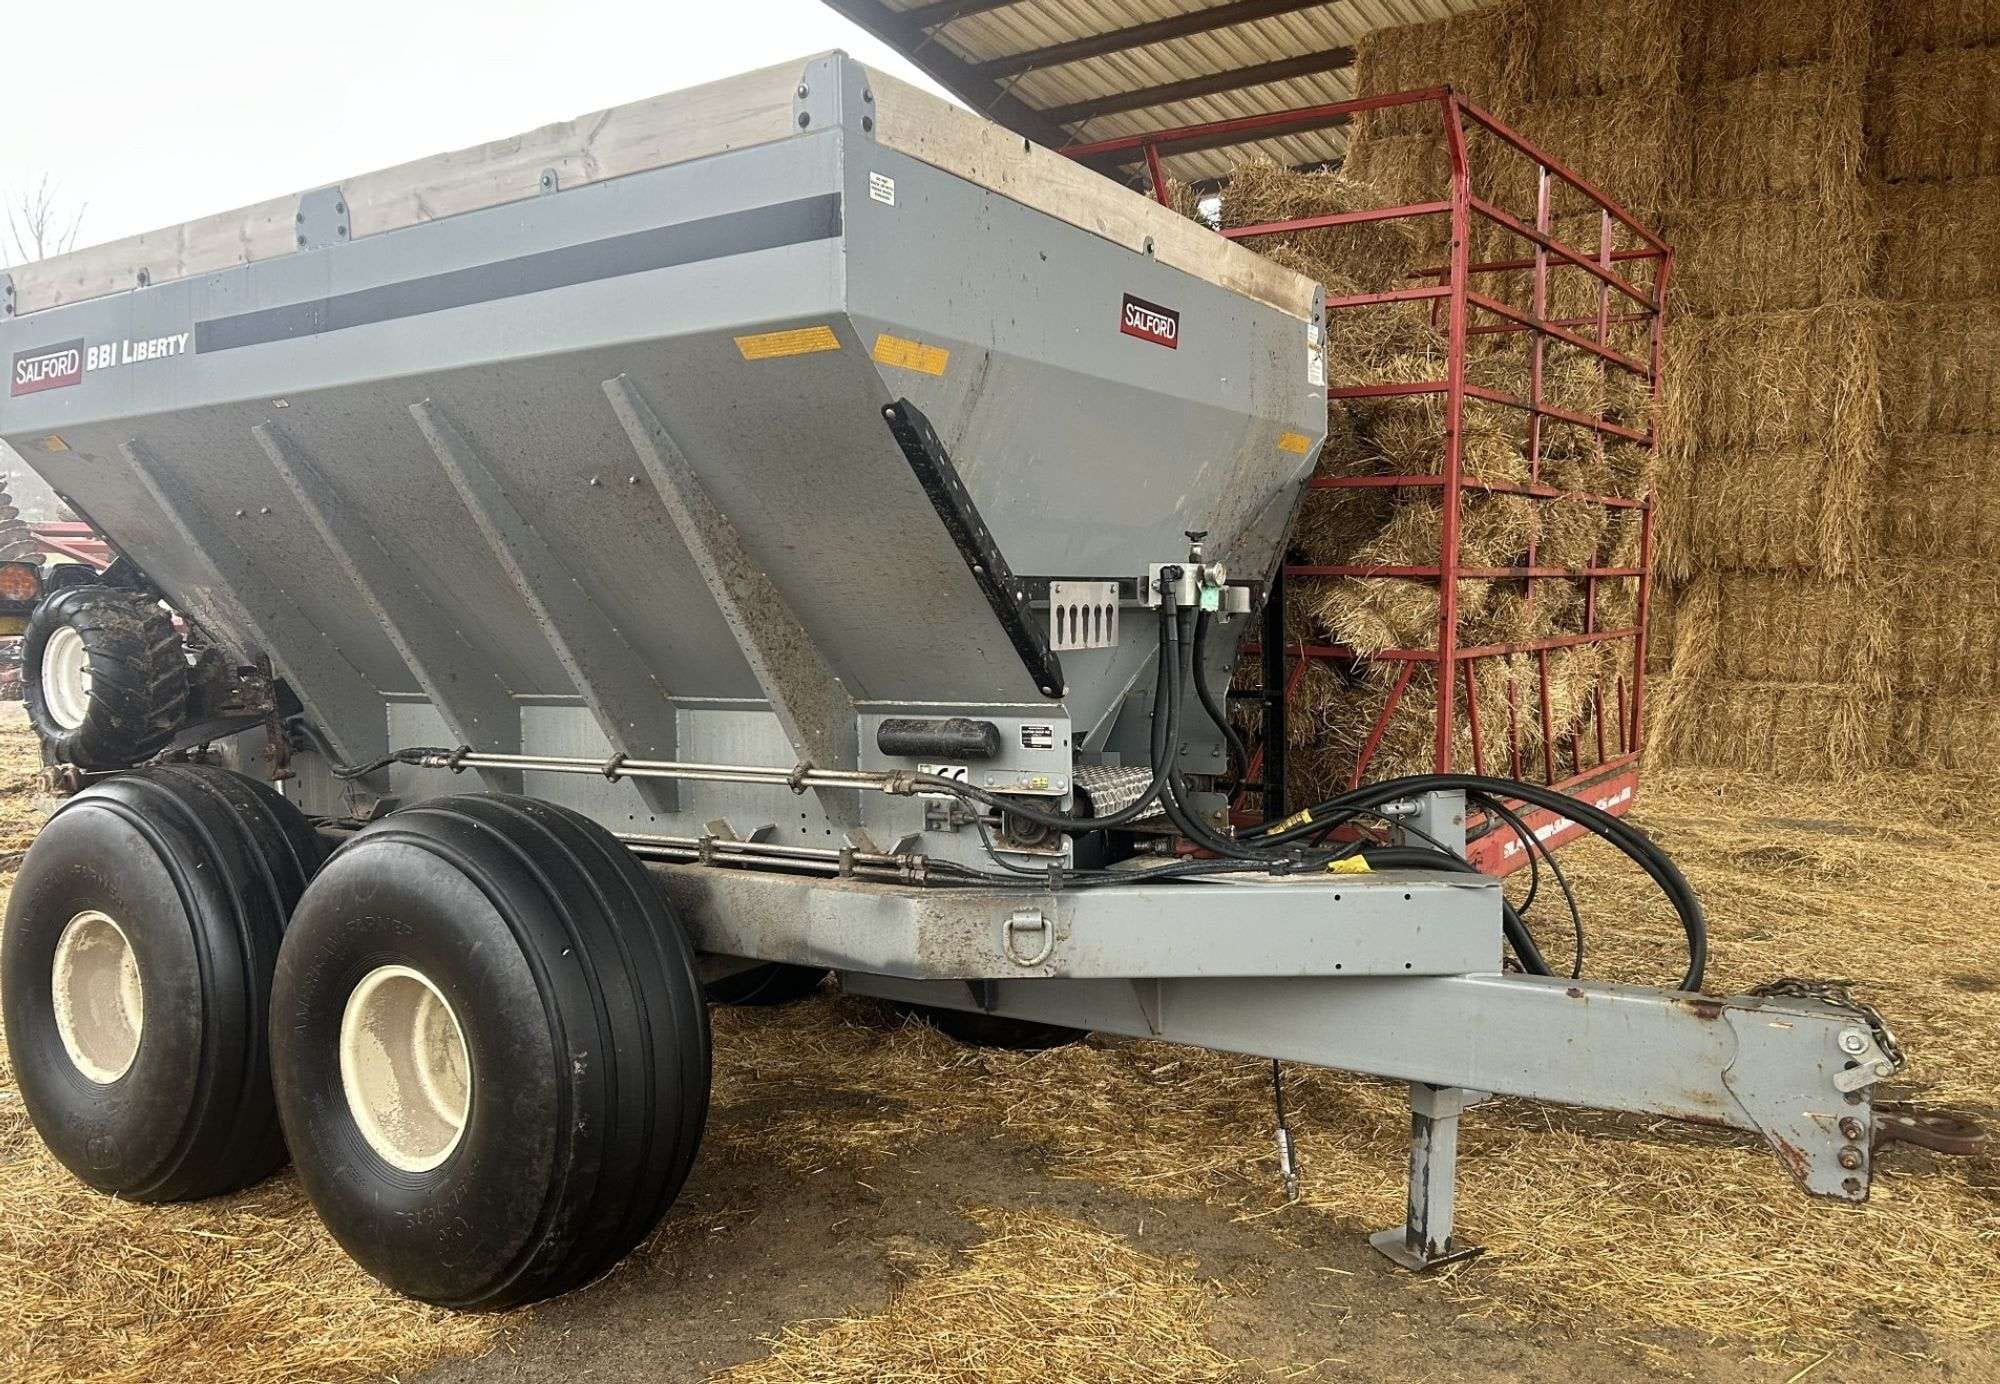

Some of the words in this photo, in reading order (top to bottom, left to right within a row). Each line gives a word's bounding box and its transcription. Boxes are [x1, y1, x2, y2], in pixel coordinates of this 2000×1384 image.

[1125, 303, 1176, 339] SALFORD
[16, 349, 79, 384] SALFORD
[86, 342, 117, 371] BBI
[122, 333, 189, 364] LIBERTY
